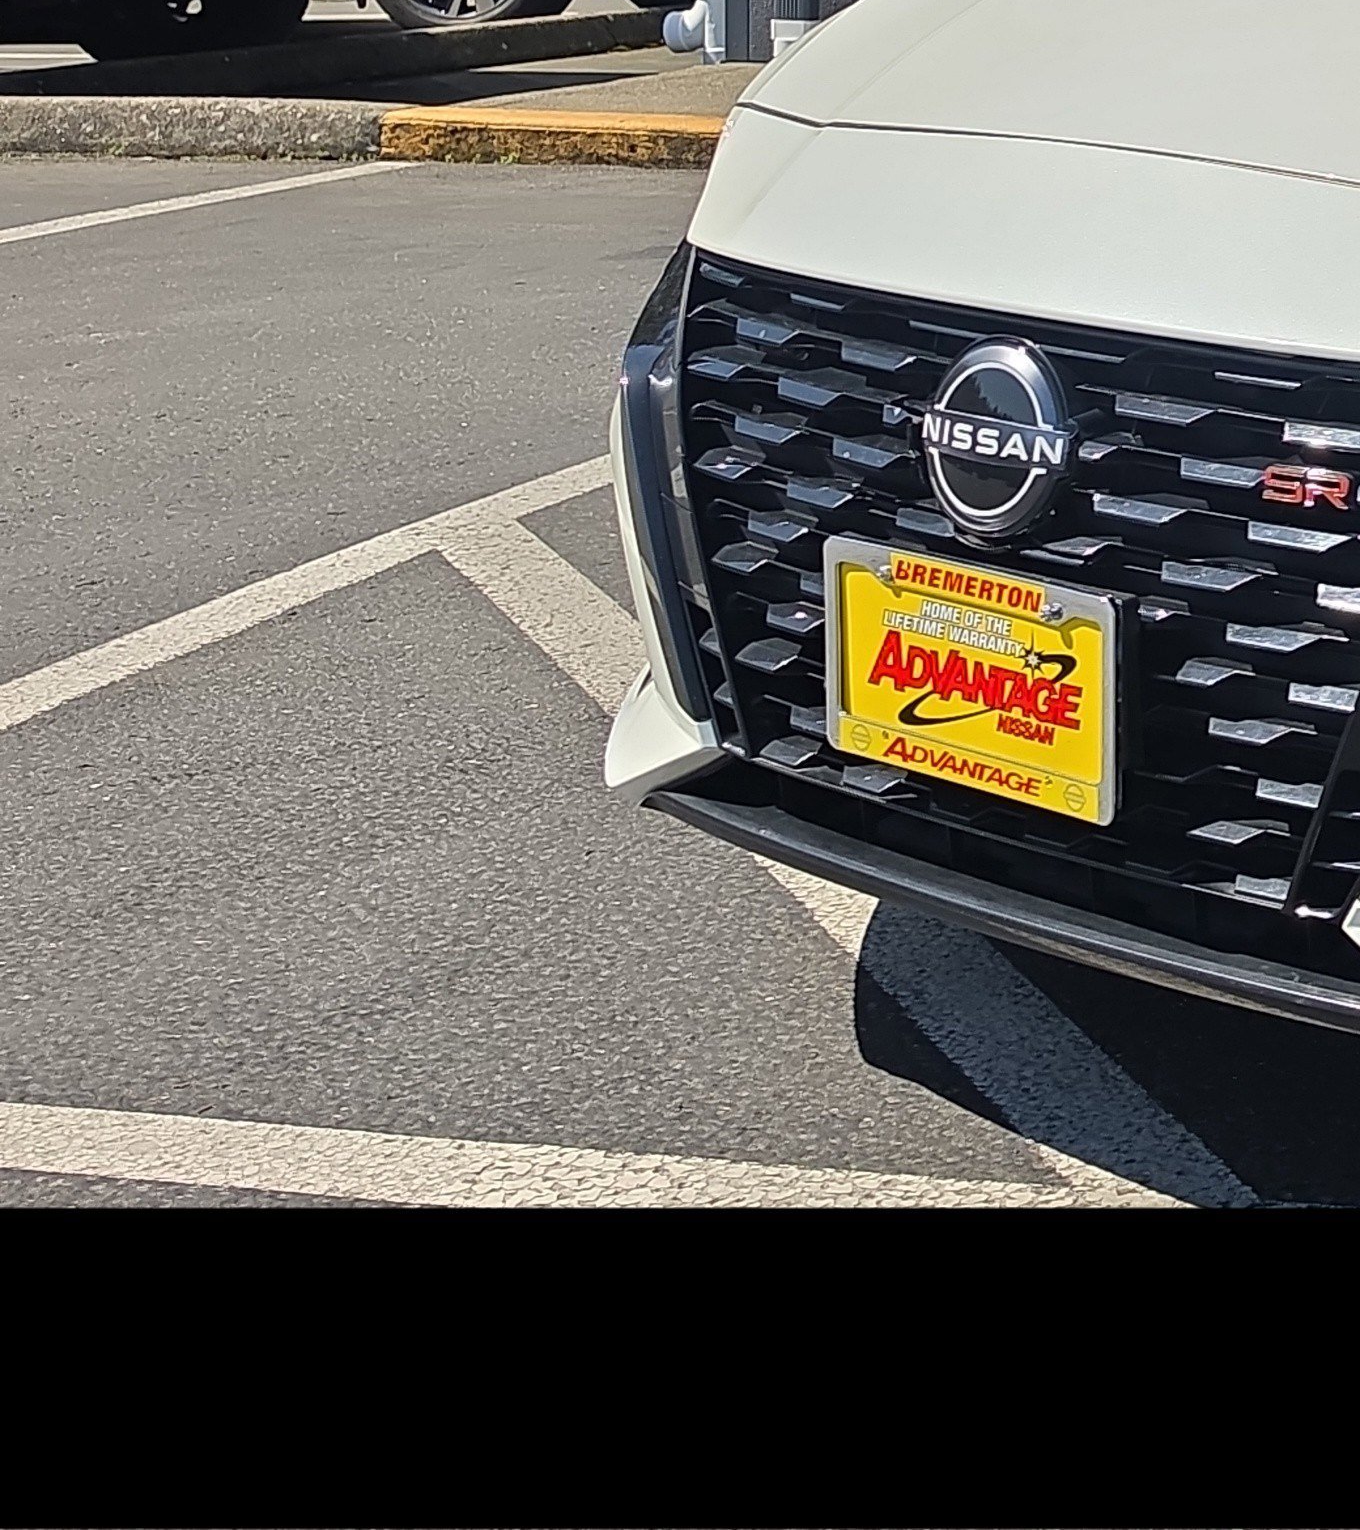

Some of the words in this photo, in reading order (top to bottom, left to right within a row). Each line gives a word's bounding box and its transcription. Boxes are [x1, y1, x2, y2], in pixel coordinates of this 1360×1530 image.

[921, 413, 1067, 466] NISSAN
[1261, 464, 1351, 510] SR
[895, 559, 1043, 613] BREMERTON
[883, 610, 945, 640] LIFETIME
[948, 624, 1024, 658] WARRANTY
[921, 600, 962, 625] HOME
[964, 610, 984, 628] OF
[986, 613, 1013, 636] THE
[868, 630, 1084, 731] ADVANTAGE
[996, 714, 1056, 747] NISSAN
[882, 736, 1042, 798] ADVANTAGE
